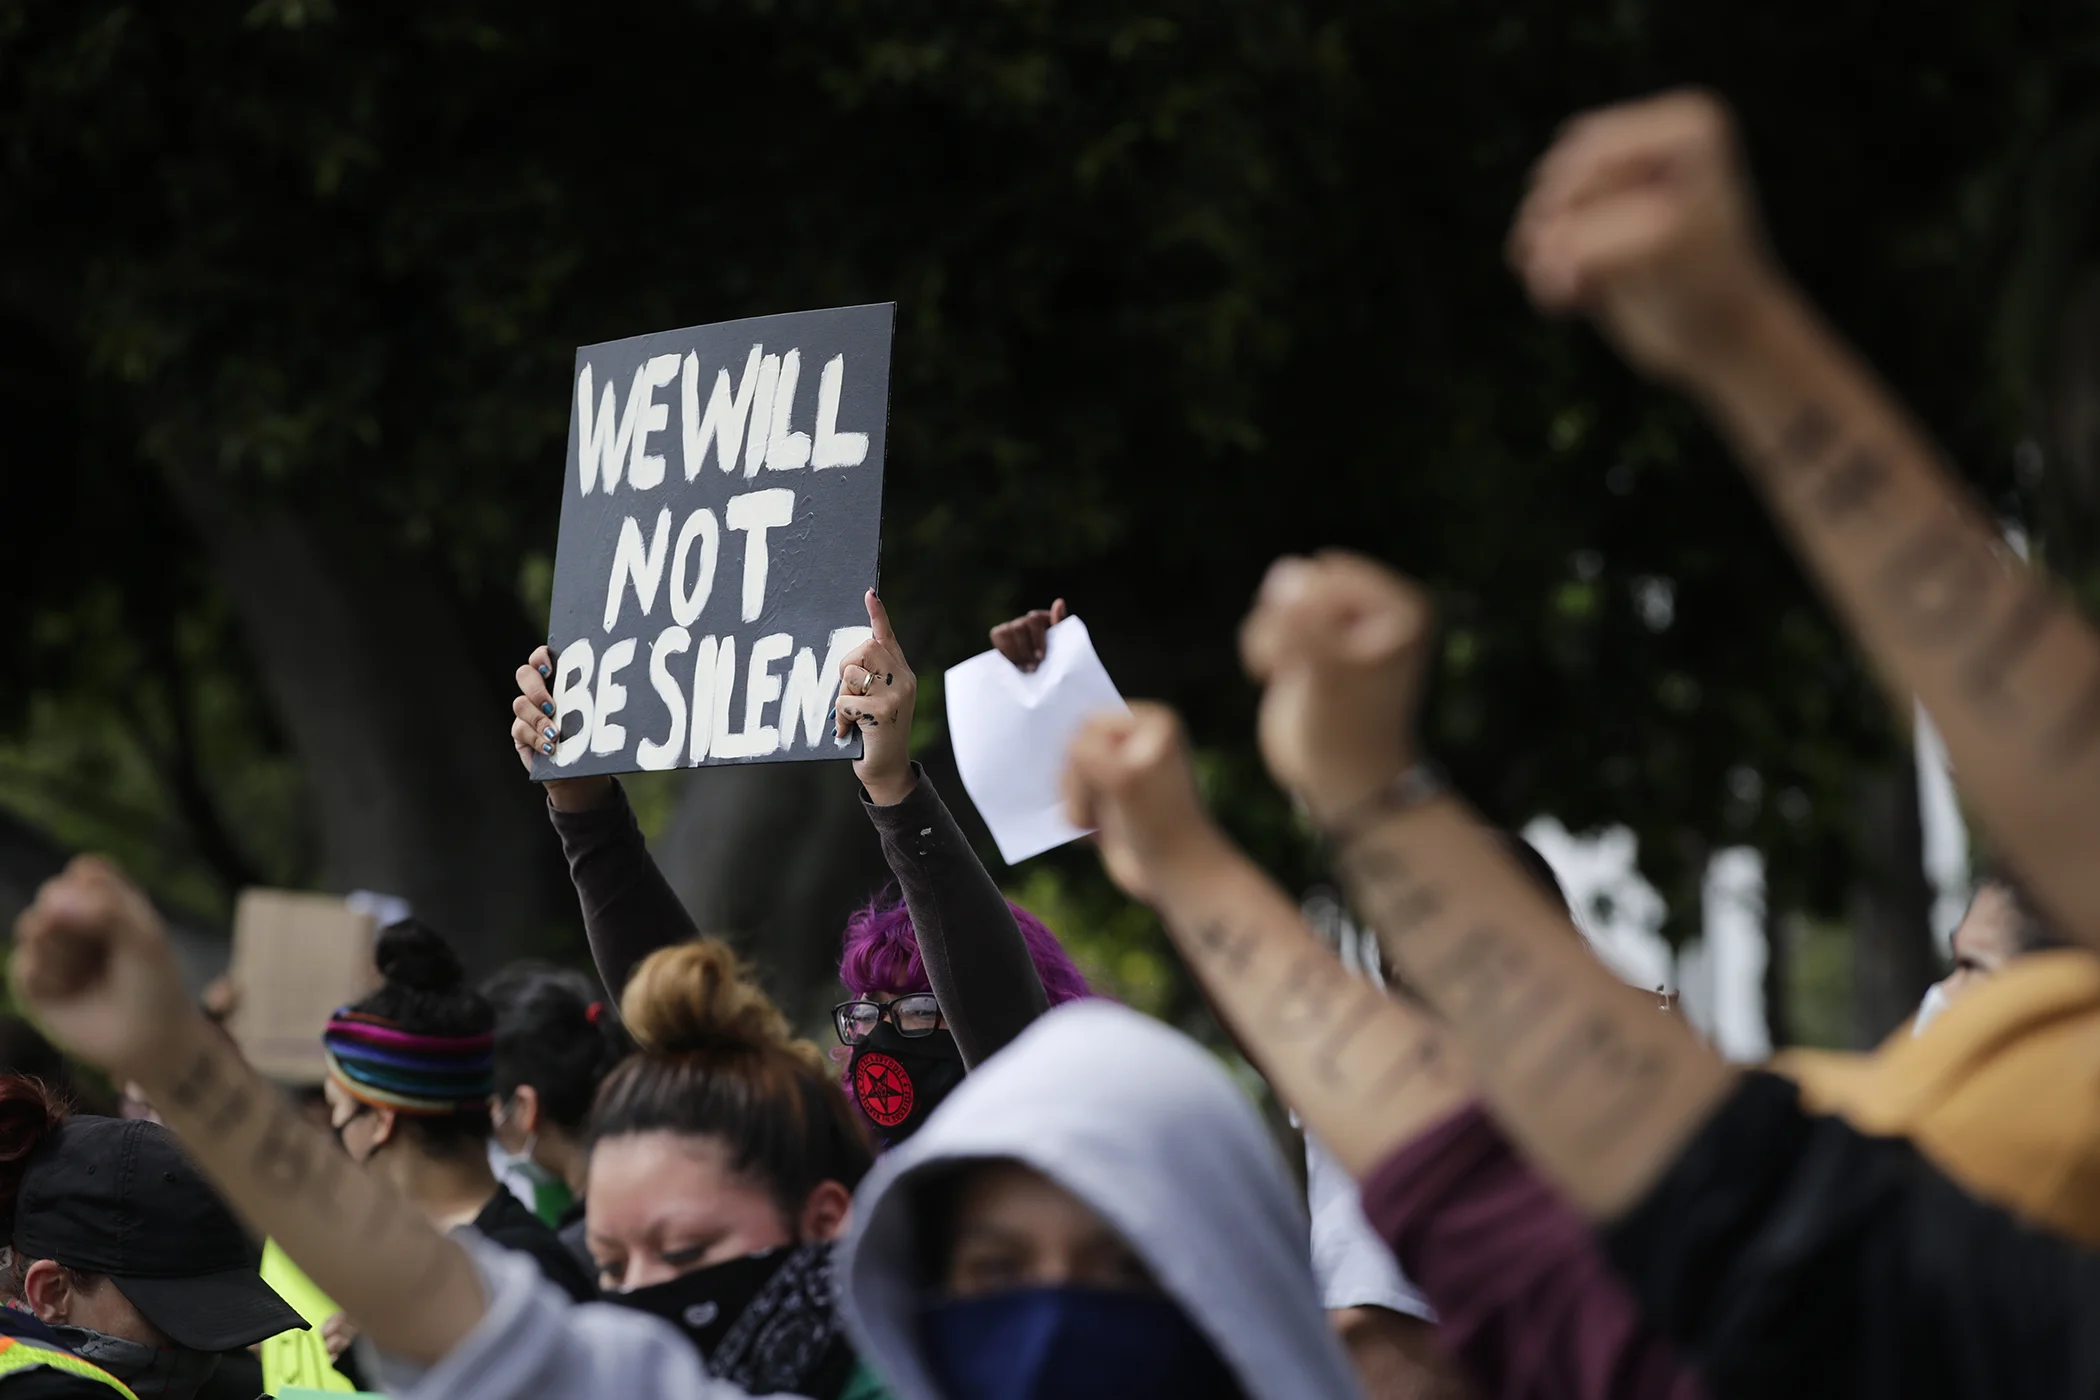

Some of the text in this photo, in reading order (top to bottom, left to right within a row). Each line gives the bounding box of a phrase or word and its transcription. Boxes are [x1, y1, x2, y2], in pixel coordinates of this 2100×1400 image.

[578, 343, 870, 497] WE WILL
[603, 487, 796, 634] NOT
[549, 637, 638, 768] BE
